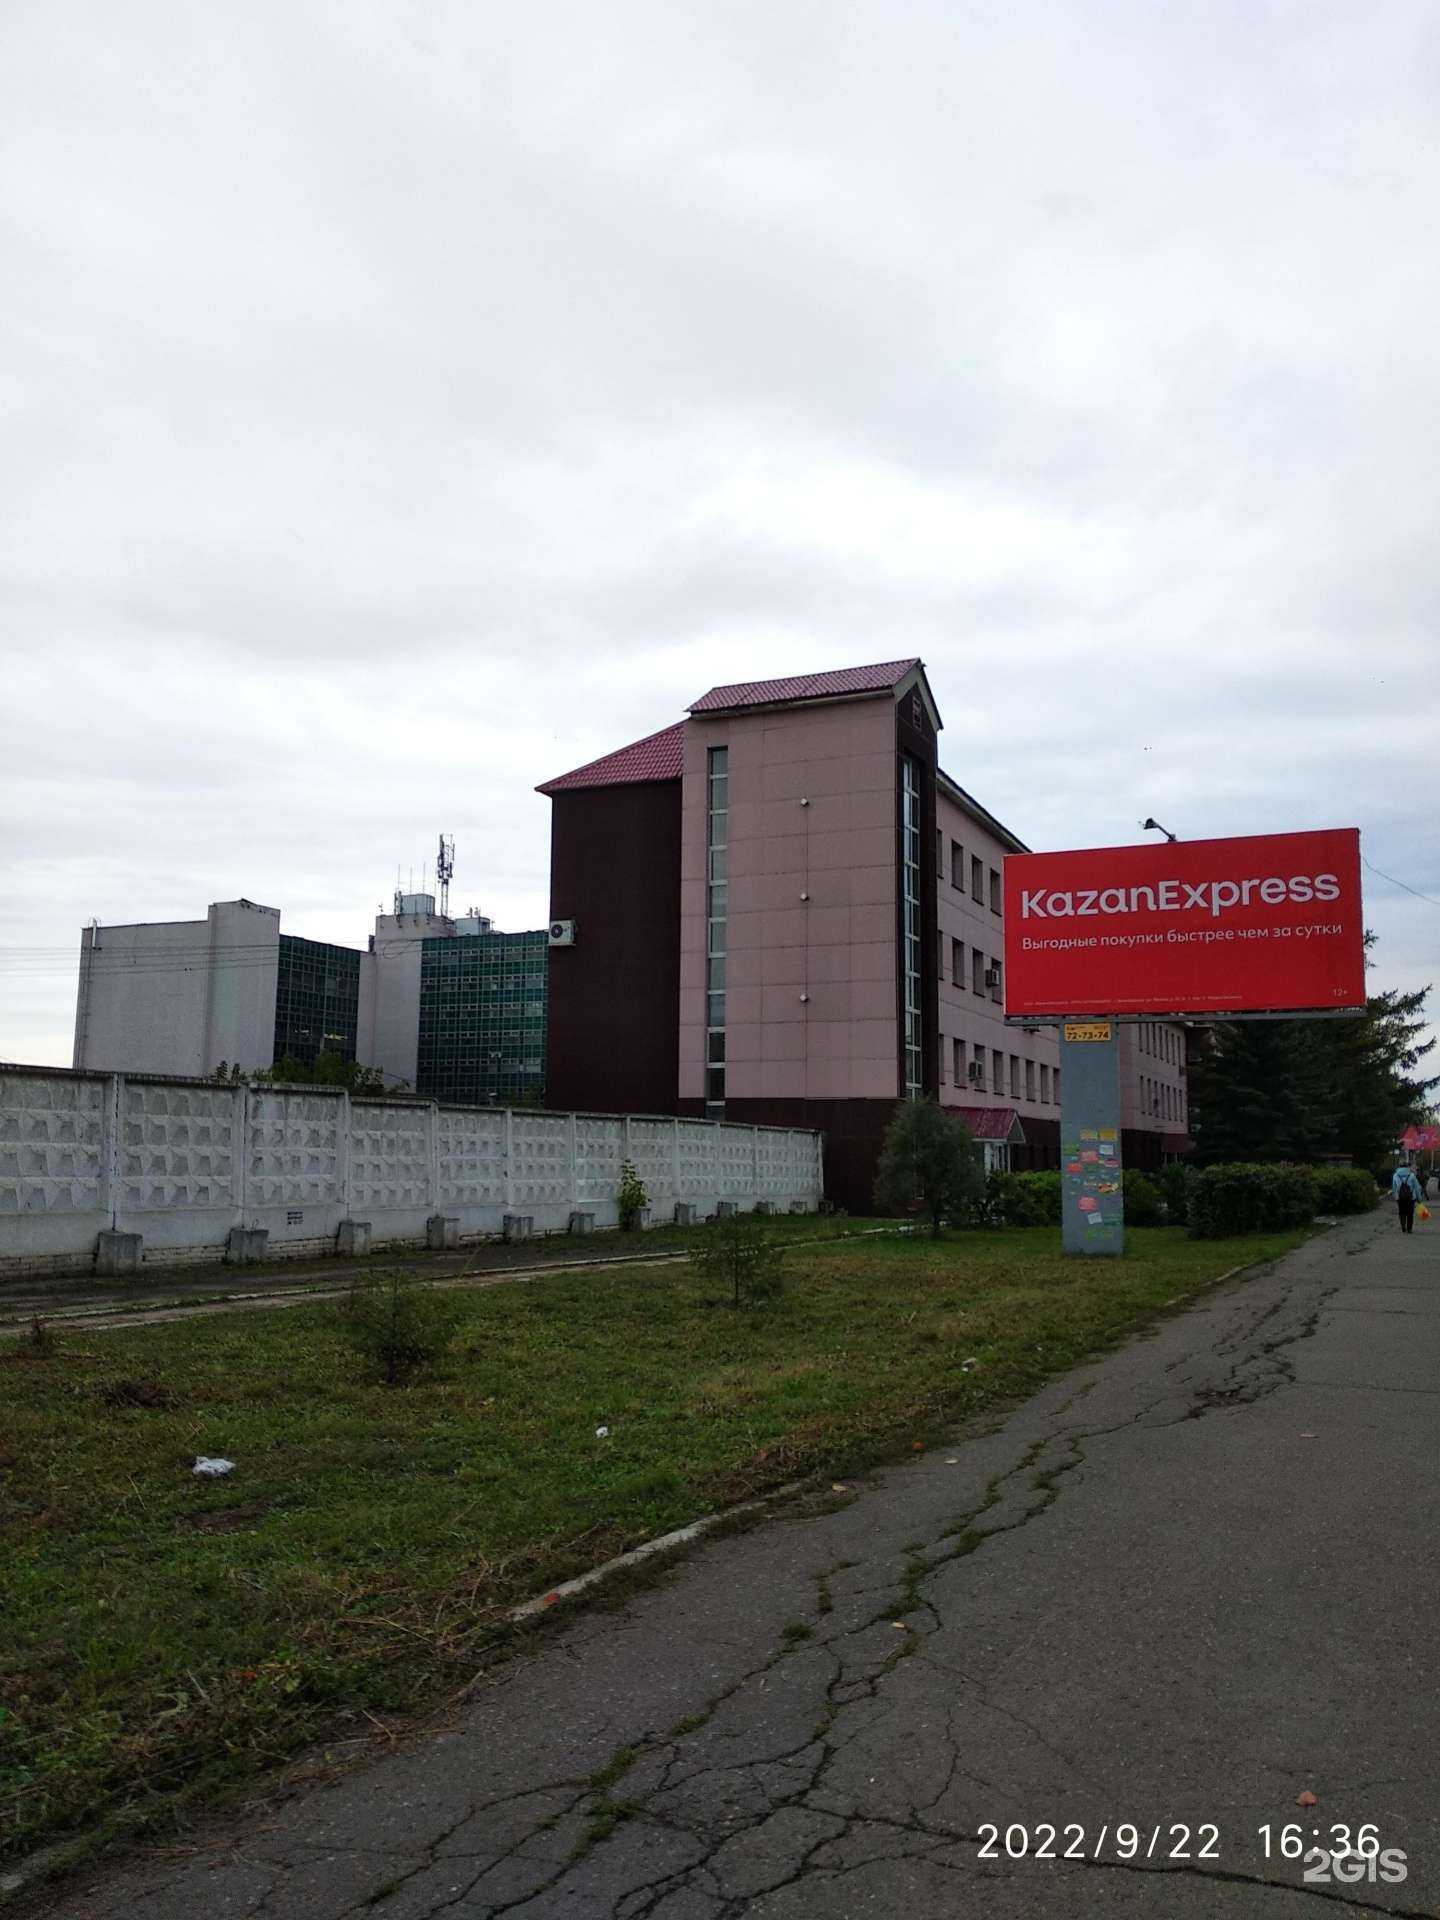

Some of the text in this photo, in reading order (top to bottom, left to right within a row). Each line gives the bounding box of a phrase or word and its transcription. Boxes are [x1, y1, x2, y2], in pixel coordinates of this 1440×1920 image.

[1021, 873, 1341, 919] KazanExpress
[1022, 923, 1343, 950] Выгодные покупки быстрее чем за сутки
